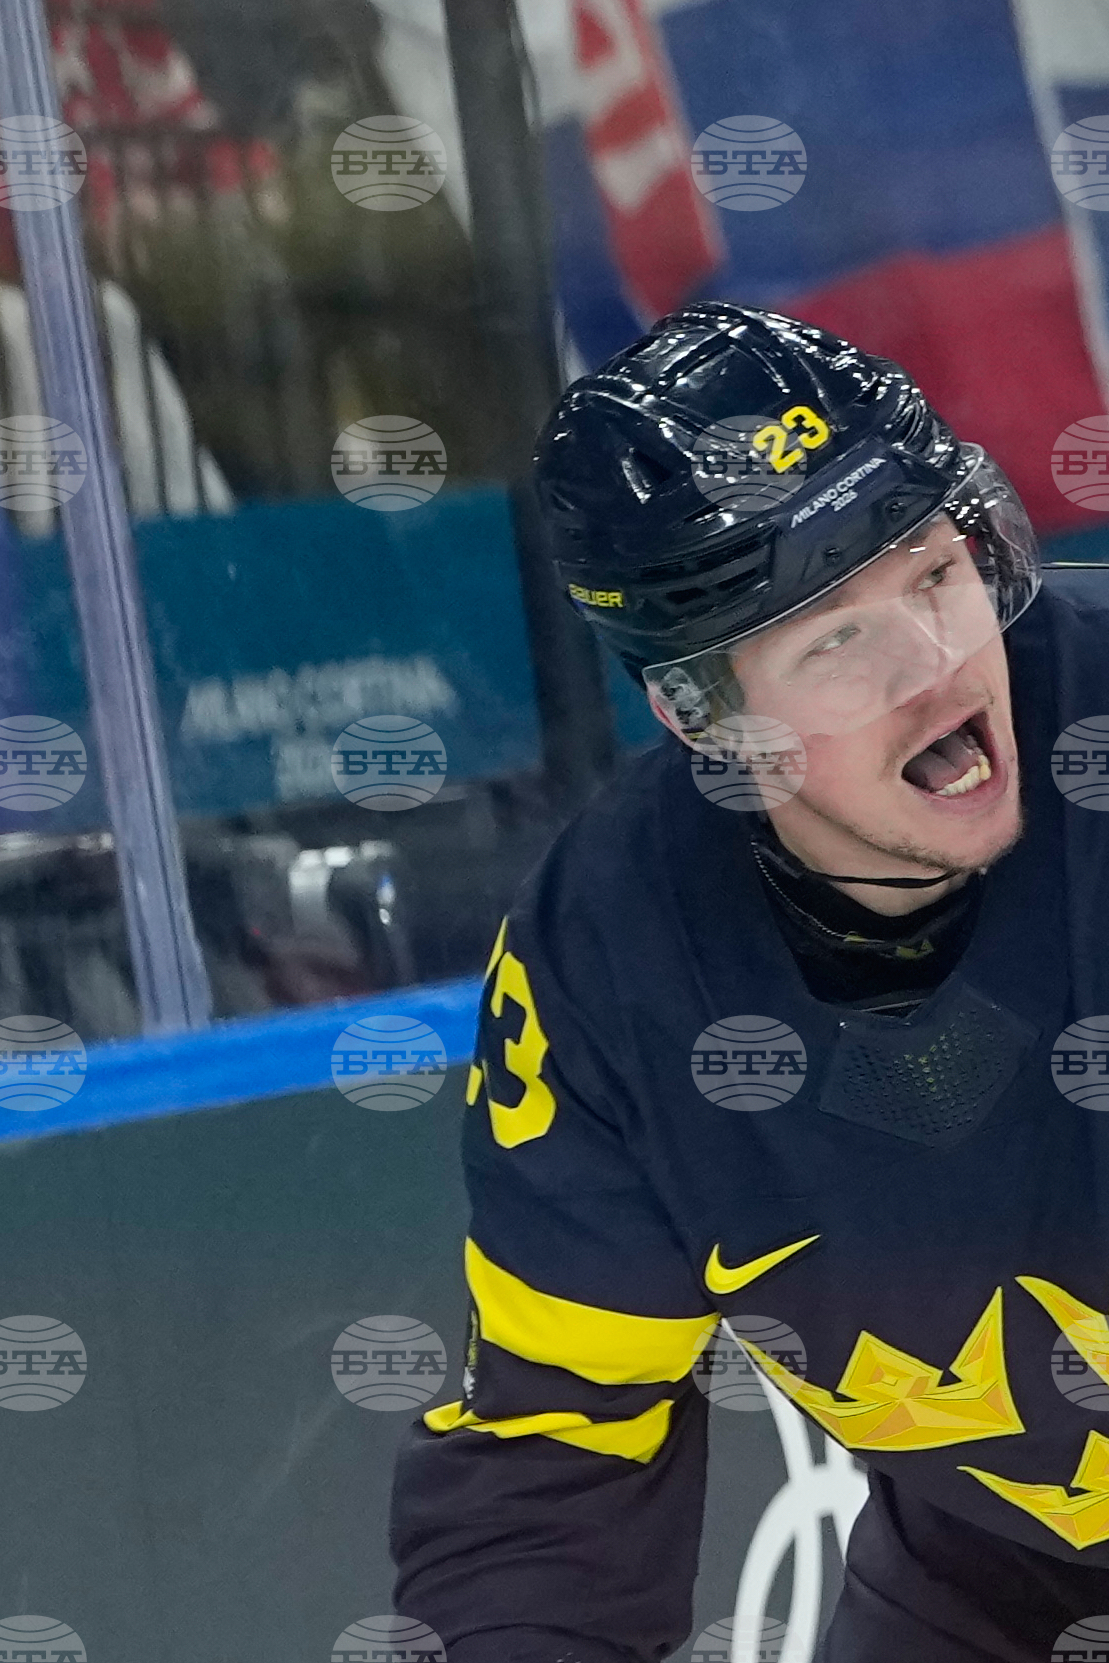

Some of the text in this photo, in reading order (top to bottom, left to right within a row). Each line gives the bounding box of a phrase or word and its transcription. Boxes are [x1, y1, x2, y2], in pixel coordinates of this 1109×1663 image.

[753, 405, 830, 474] 23
[791, 457, 887, 528] MILANO CORTINA
[466, 915, 557, 1150] 3
